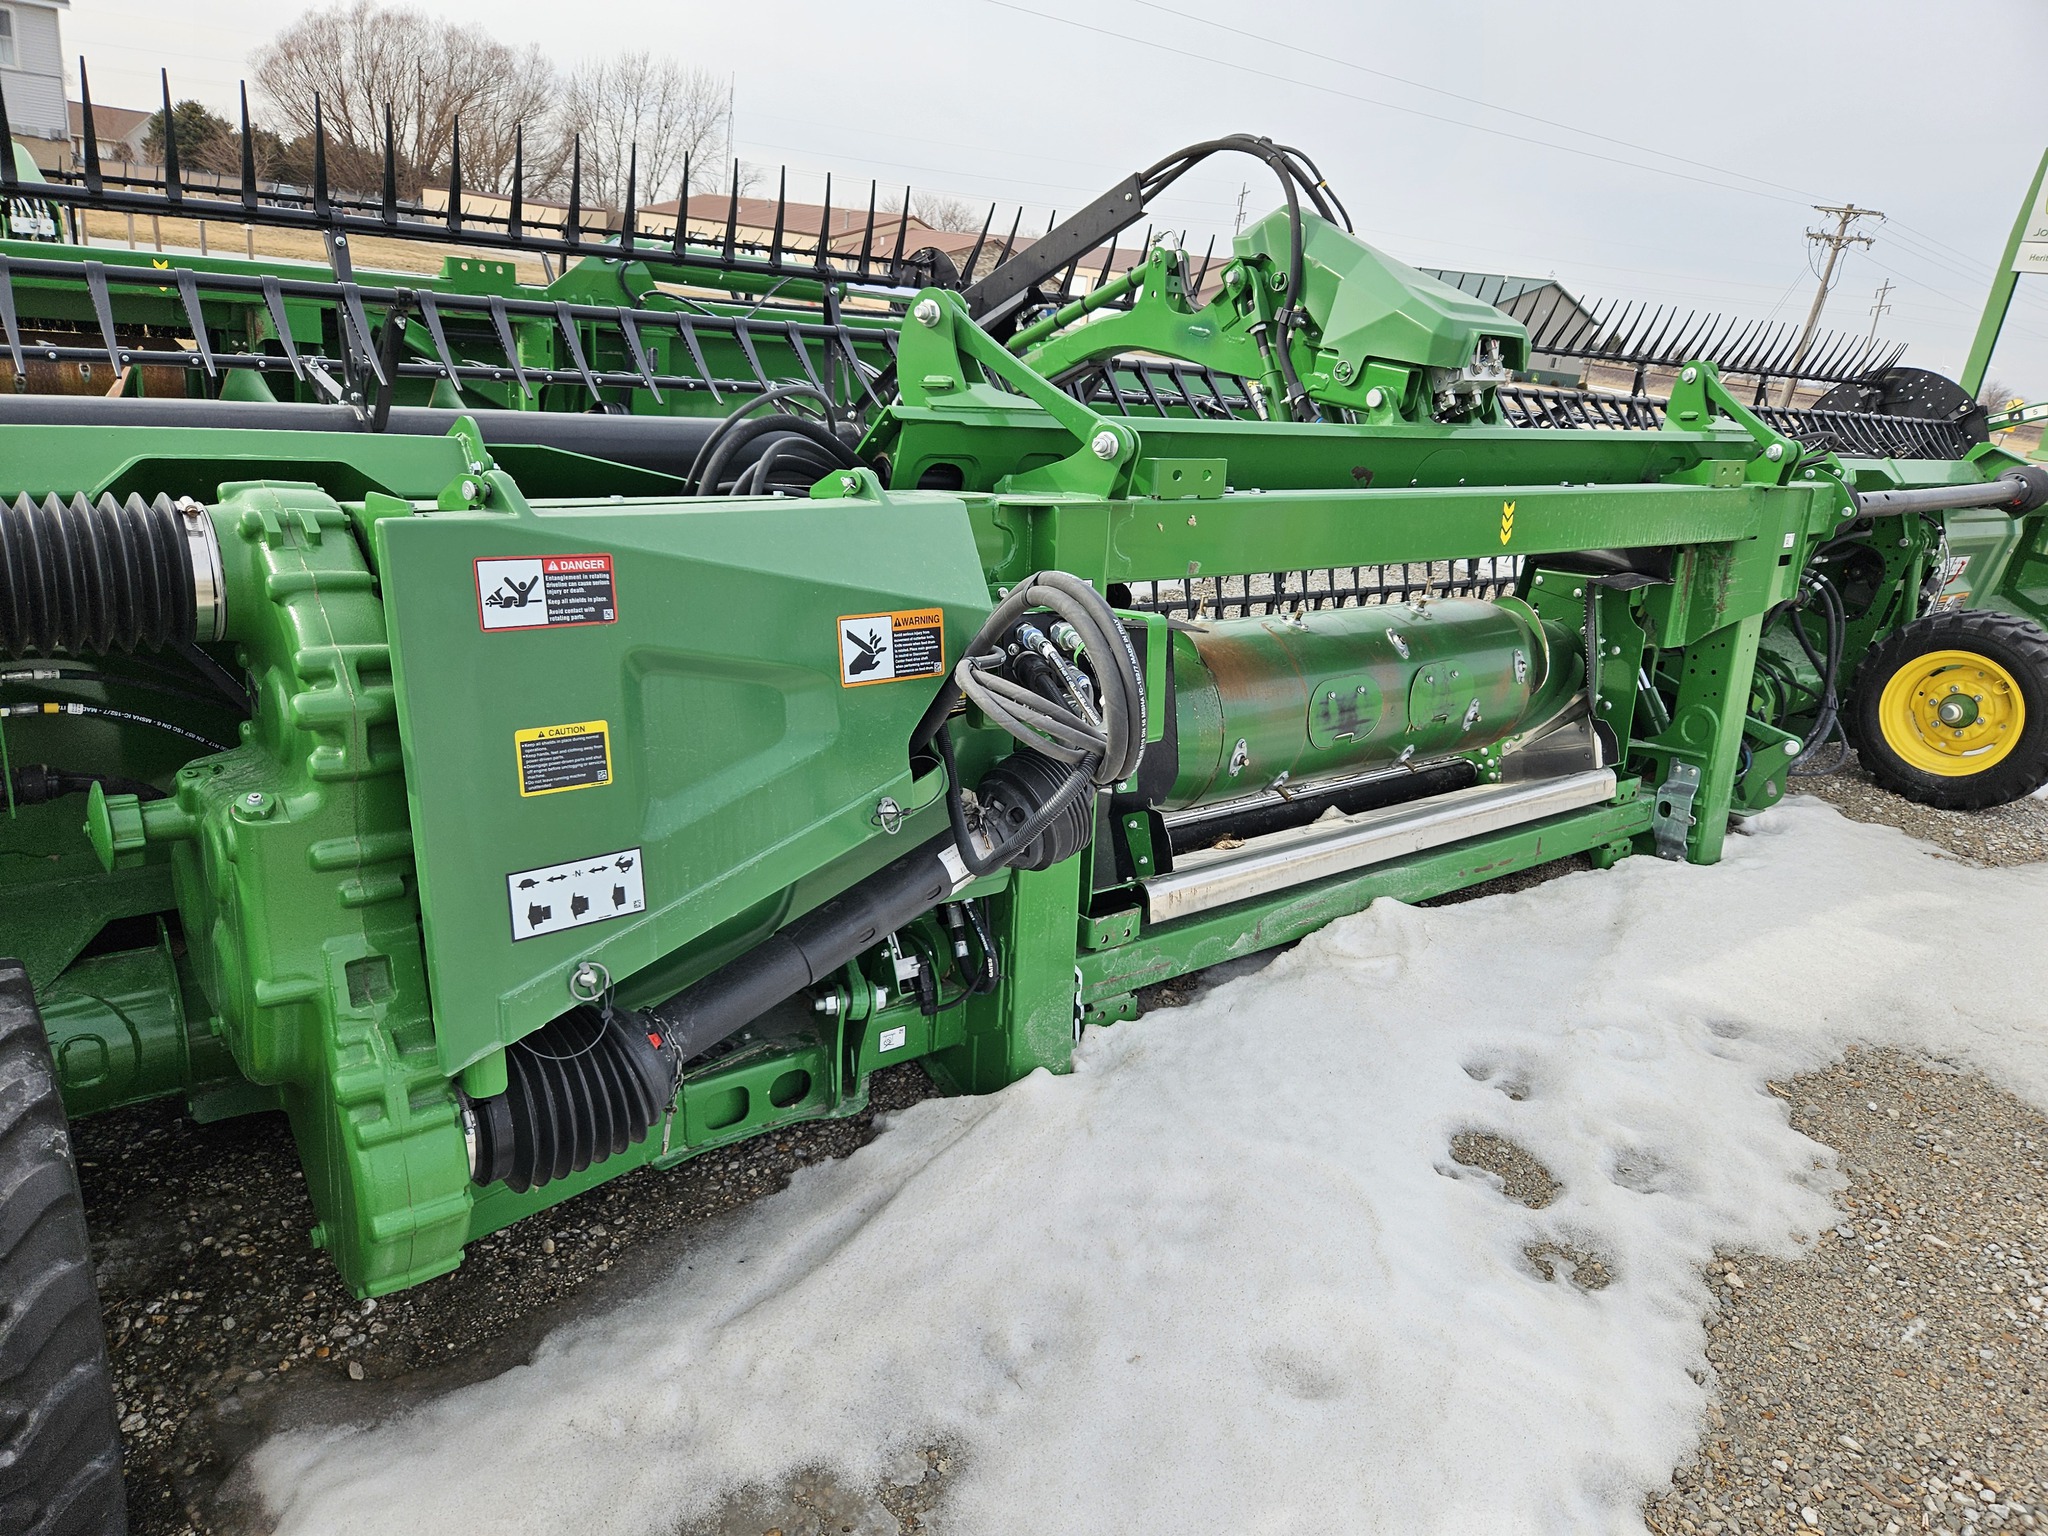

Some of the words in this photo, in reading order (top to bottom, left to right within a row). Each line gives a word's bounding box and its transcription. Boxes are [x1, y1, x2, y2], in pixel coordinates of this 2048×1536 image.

[560, 560, 604, 570] DANGER
[902, 614, 940, 626] WARNING
[1113, 618, 1125, 634] ITALY
[1126, 643, 1136, 664] MADE
[133, 714, 152, 724] MSHA
[548, 726, 585, 736] CAUTION
